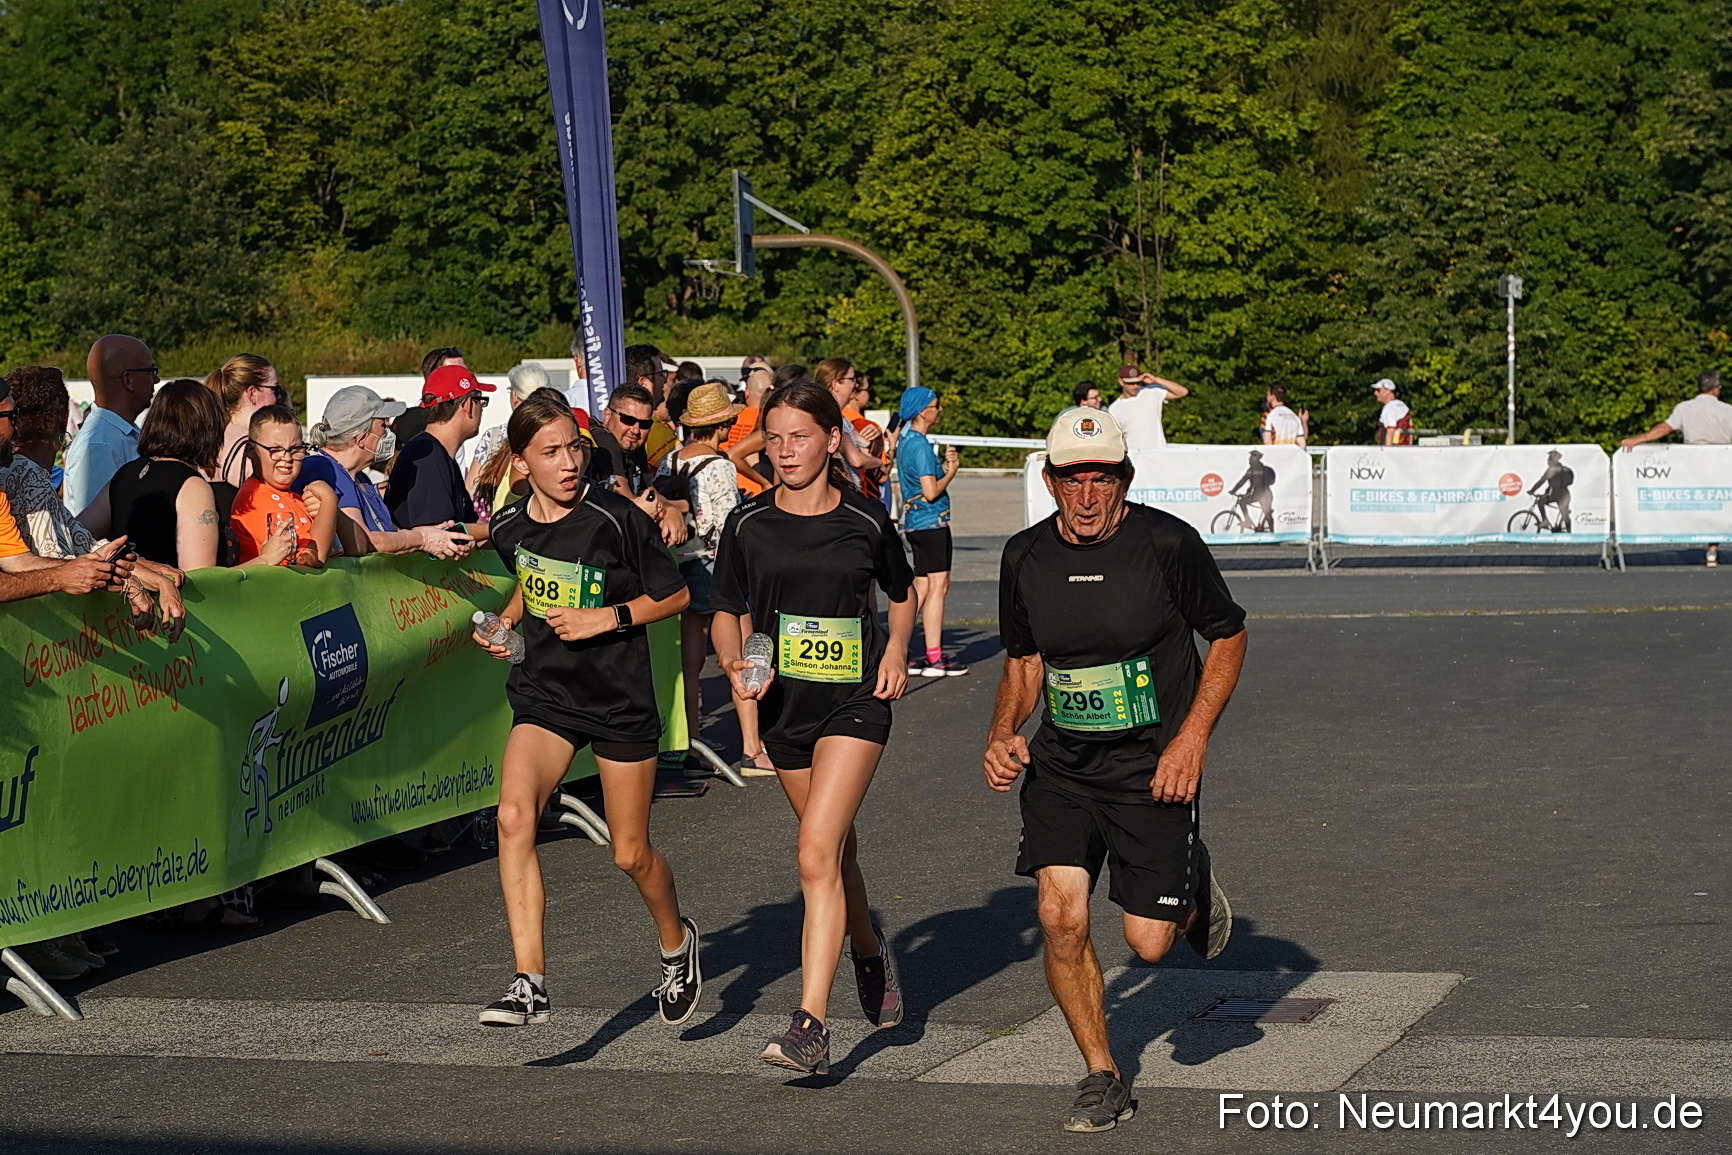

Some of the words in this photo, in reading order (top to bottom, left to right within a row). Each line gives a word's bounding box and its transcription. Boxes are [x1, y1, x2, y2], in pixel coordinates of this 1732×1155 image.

[1350, 467, 1385, 480] NOW
[1637, 467, 1671, 479] NOW
[1130, 487, 1201, 502] AHRRÄDER
[1352, 490, 1403, 502] E-BIKES
[1406, 490, 1417, 502] &
[1421, 486, 1501, 502] FAHRRÄDER
[1640, 489, 1691, 501] E-BIKES
[1695, 489, 1704, 501] &
[525, 574, 560, 601] 498
[568, 587, 577, 608] 022
[23, 612, 104, 688] Gesunde
[321, 643, 359, 671] Fischer
[784, 639, 792, 669] WALK
[799, 639, 844, 661] 299
[851, 644, 859, 673] 2022
[328, 661, 358, 681] AUTOMOBILE
[790, 659, 818, 669] Simson
[820, 662, 852, 671] Johanna
[66, 673, 131, 735] laufen
[128, 637, 205, 713] länger!
[1049, 692, 1058, 715] RUN
[1060, 690, 1105, 712] 296
[1113, 689, 1127, 721] 2022
[1060, 710, 1084, 720] Schön
[1086, 711, 1112, 720] Albert
[276, 677, 406, 794] firmenlauf
[277, 774, 326, 822] neumarkt
[1157, 895, 1179, 906] JAKO
